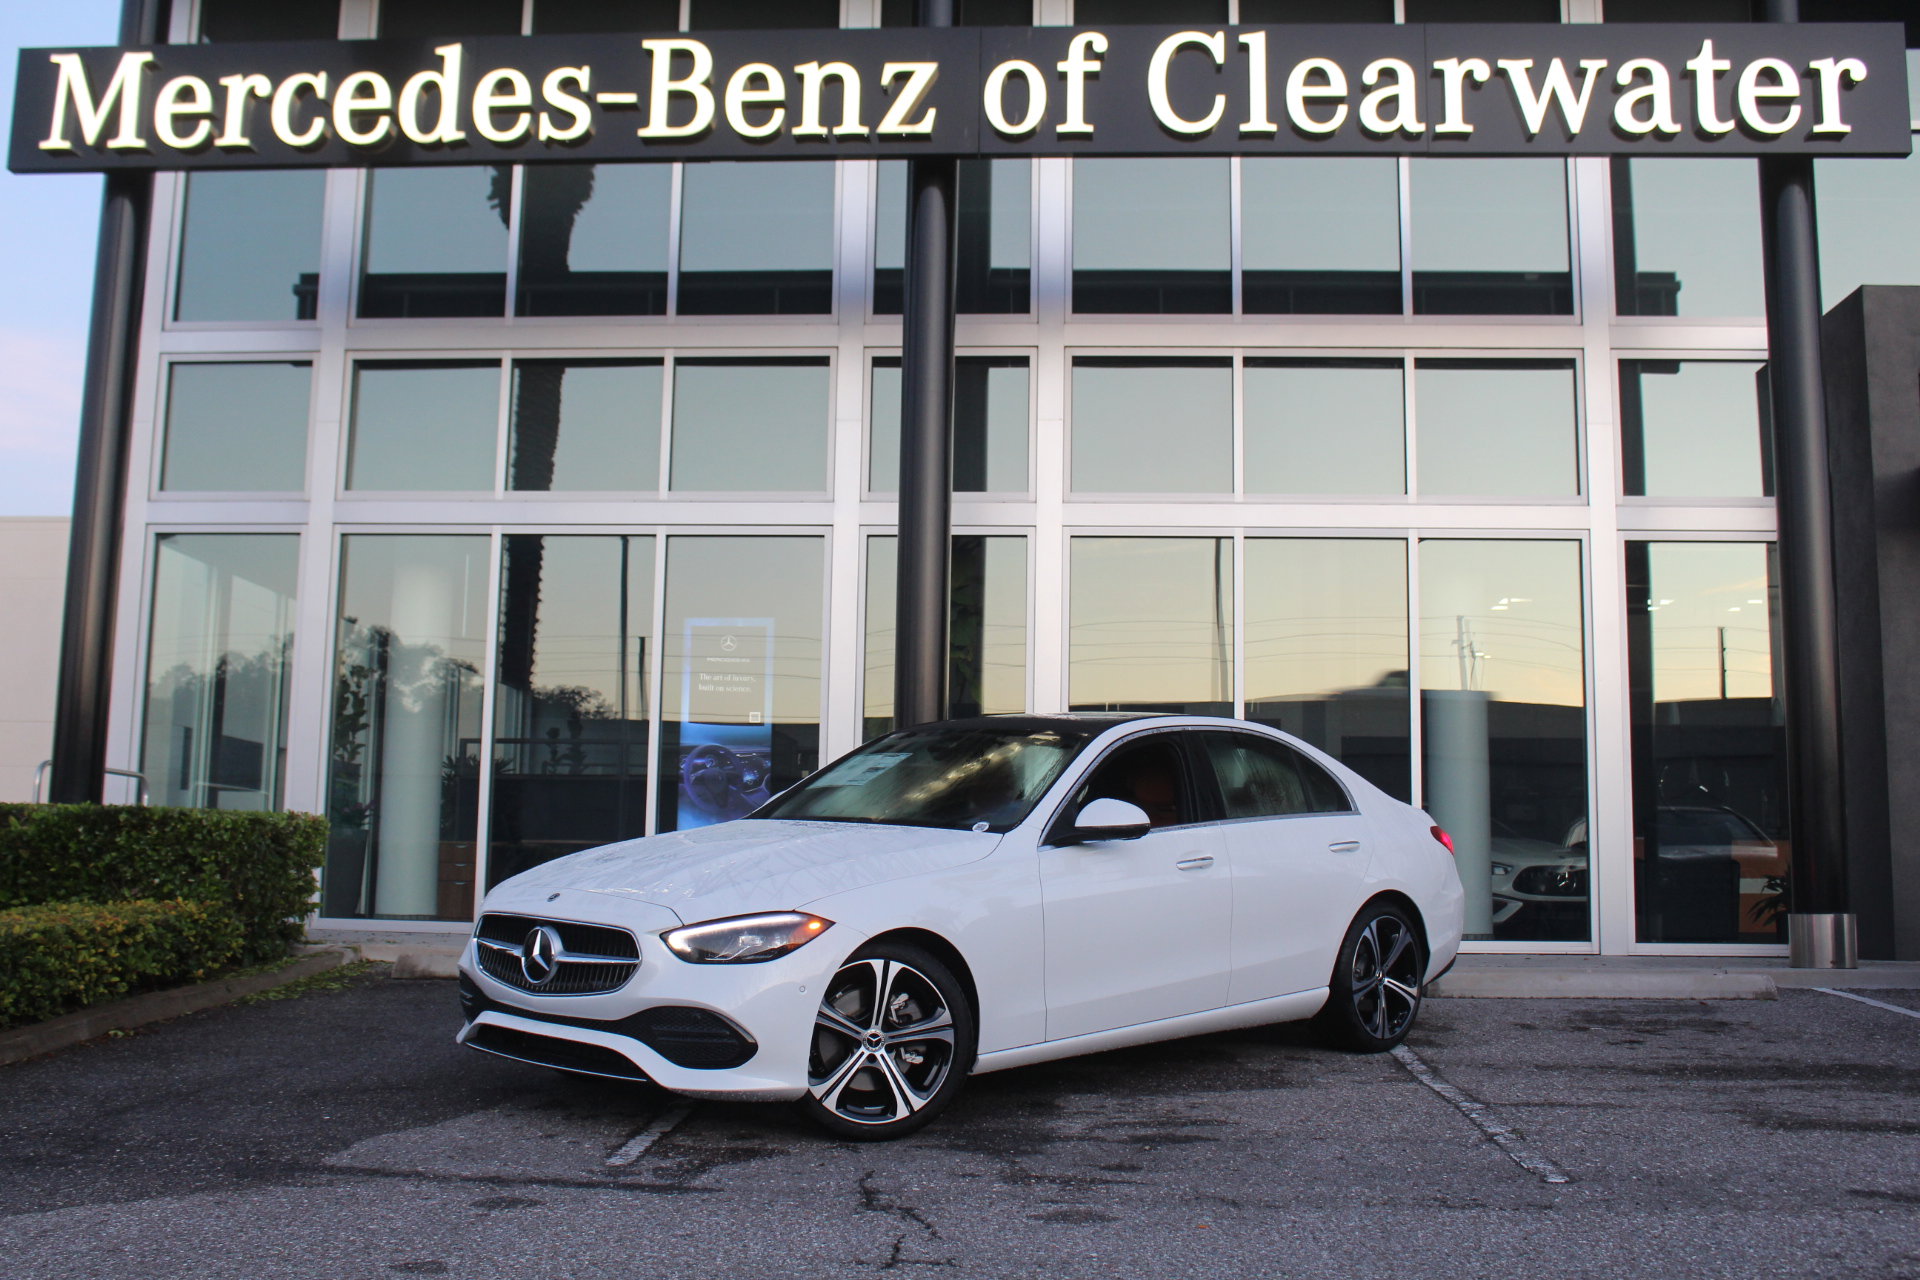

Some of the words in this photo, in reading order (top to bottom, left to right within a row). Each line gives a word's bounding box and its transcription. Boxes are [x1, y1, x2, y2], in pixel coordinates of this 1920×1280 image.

[38, 39, 939, 150] Mercedes-Benz
[983, 32, 1109, 134] of
[1147, 30, 1868, 134] Clearwater
